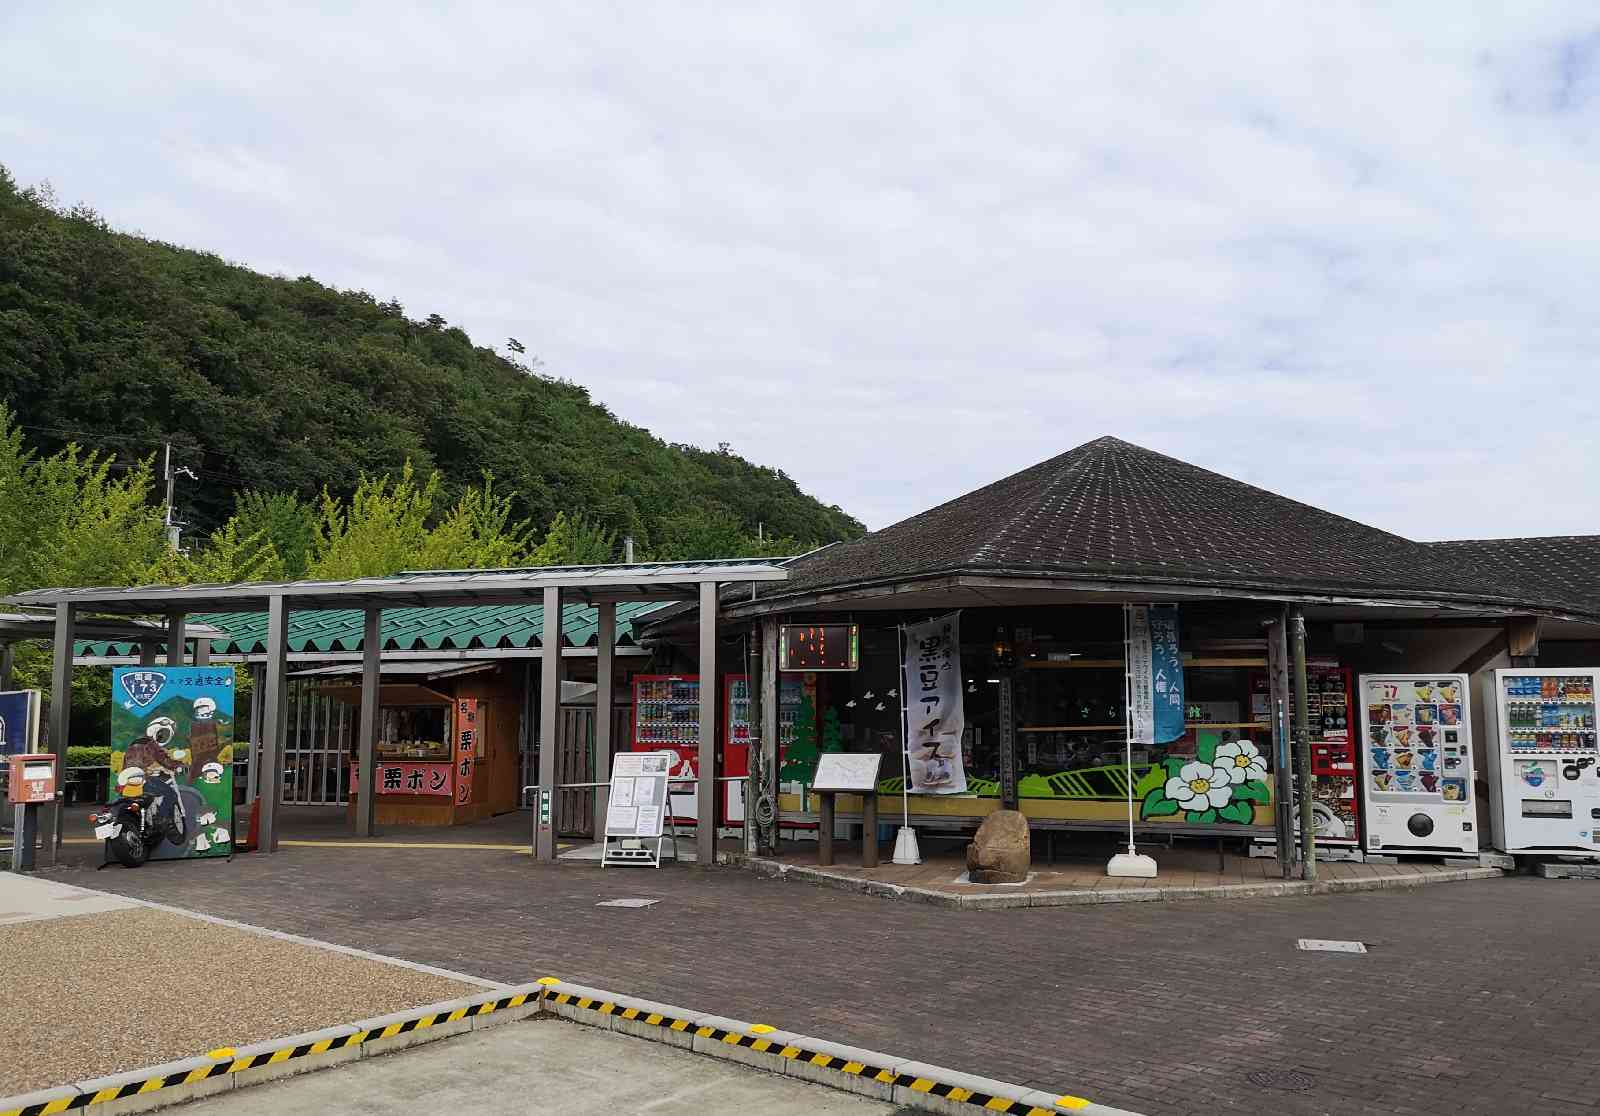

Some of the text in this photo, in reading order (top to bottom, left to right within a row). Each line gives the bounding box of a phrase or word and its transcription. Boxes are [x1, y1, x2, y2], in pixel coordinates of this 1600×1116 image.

[130, 683, 158, 694] 173
[383, 767, 447, 791] 栗ポン
